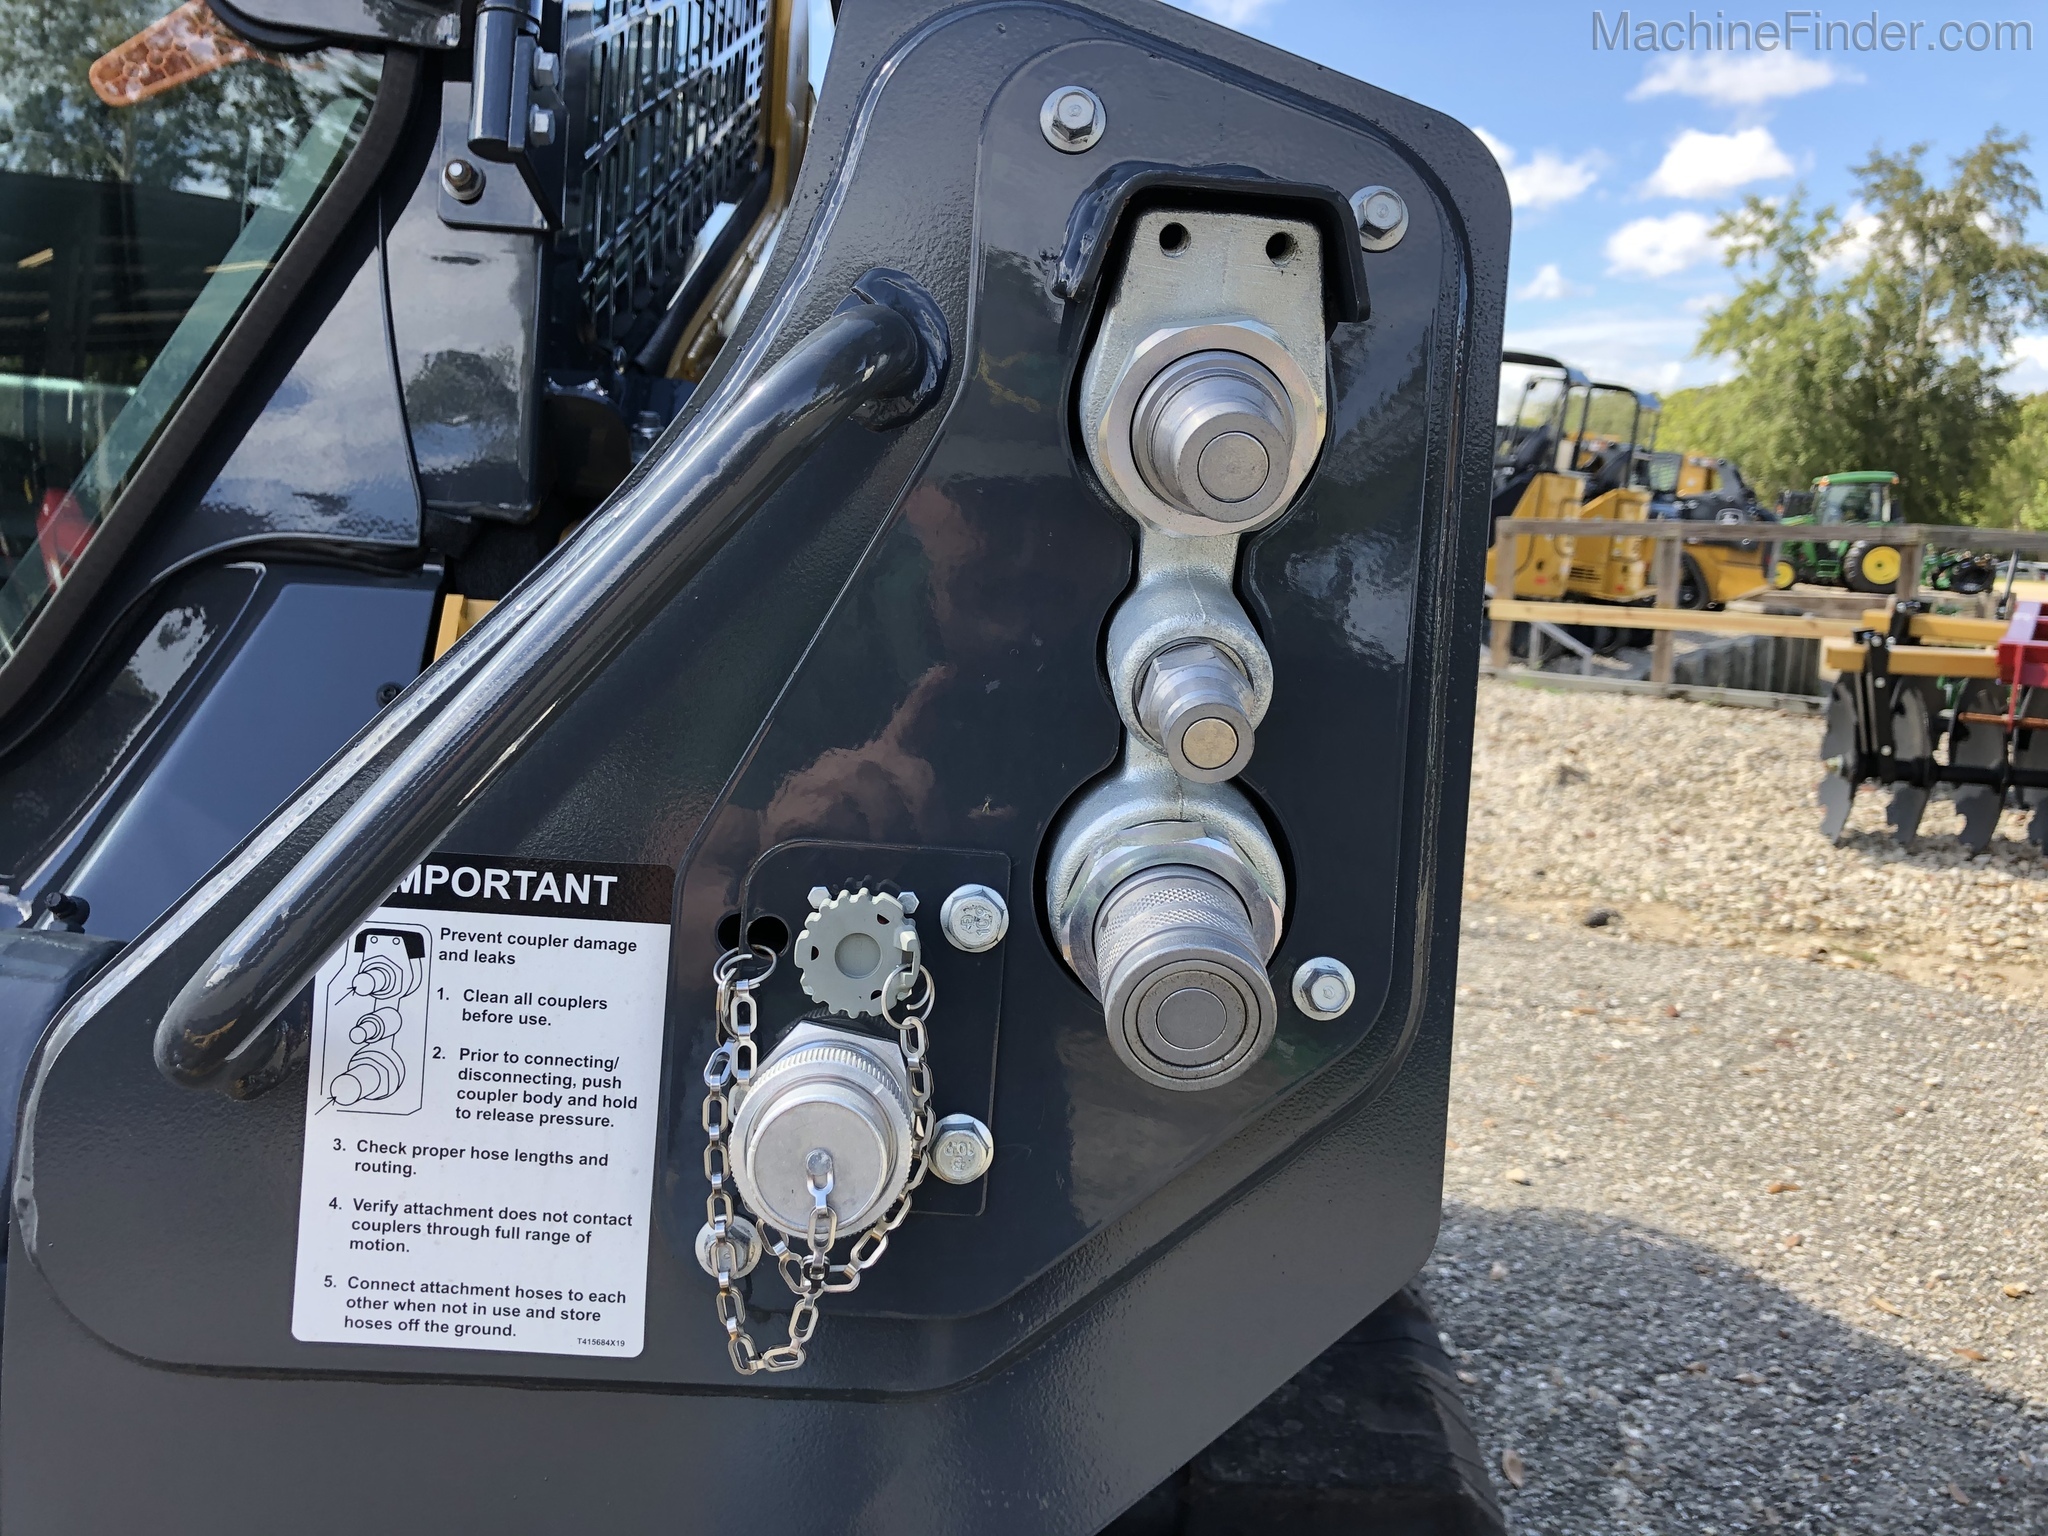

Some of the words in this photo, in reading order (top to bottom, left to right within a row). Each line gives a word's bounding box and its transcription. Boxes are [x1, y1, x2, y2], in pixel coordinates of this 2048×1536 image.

[394, 864, 618, 906] MPORTANT
[440, 927, 503, 944] Prevent
[507, 934, 569, 950] coupler
[573, 935, 637, 955] damage
[438, 949, 469, 962] and
[474, 949, 516, 965] leaks
[437, 987, 449, 1001] 1.
[463, 988, 509, 1004] Clean
[513, 992, 533, 1006] all
[537, 995, 608, 1011] couplers
[462, 1008, 513, 1024] before
[518, 1014, 551, 1026] use.
[432, 1046, 446, 1060] 2.
[459, 1047, 499, 1063] Prior
[503, 1050, 519, 1064] to
[524, 1054, 620, 1073] connecting/
[458, 1067, 576, 1090] disconnecting,
[582, 1075, 622, 1091] push
[456, 1088, 519, 1105] coupler
[523, 1090, 563, 1109] body
[567, 1094, 598, 1107] and
[602, 1094, 638, 1110] hold
[455, 1106, 471, 1119] to
[476, 1108, 534, 1123] release
[539, 1113, 614, 1128] pressure.
[333, 1138, 346, 1151] 3.
[357, 1139, 407, 1155] Check
[412, 1146, 466, 1160] proper
[470, 1146, 509, 1161] hose
[514, 1148, 574, 1167] lengths
[578, 1153, 609, 1167] and
[355, 1160, 416, 1178] routing.
[328, 1197, 342, 1210] 4.
[353, 1198, 399, 1216] Verify
[403, 1202, 494, 1219] attachment
[498, 1206, 537, 1221] does
[542, 1211, 569, 1223] not
[573, 1213, 633, 1227] contact
[351, 1219, 421, 1235] couplers
[426, 1222, 490, 1241] through
[495, 1225, 520, 1240] full
[525, 1230, 570, 1245] range
[575, 1230, 592, 1244] of
[349, 1238, 410, 1253] motion.
[324, 1275, 336, 1288] 5.
[348, 1276, 416, 1292] Connect
[420, 1281, 510, 1298] attachment
[515, 1285, 563, 1301] hoses
[568, 1289, 584, 1302] to
[588, 1290, 626, 1304] each
[346, 1296, 389, 1310] other
[393, 1298, 436, 1313] when
[442, 1302, 468, 1315] not
[473, 1302, 487, 1315] in
[492, 1306, 521, 1317] use
[525, 1306, 555, 1319] and
[560, 1308, 601, 1322] store
[344, 1315, 392, 1330] hoses
[398, 1318, 421, 1332] off
[424, 1319, 449, 1333] the
[454, 1324, 516, 1337] ground.
[577, 1338, 625, 1347] T415684X19
